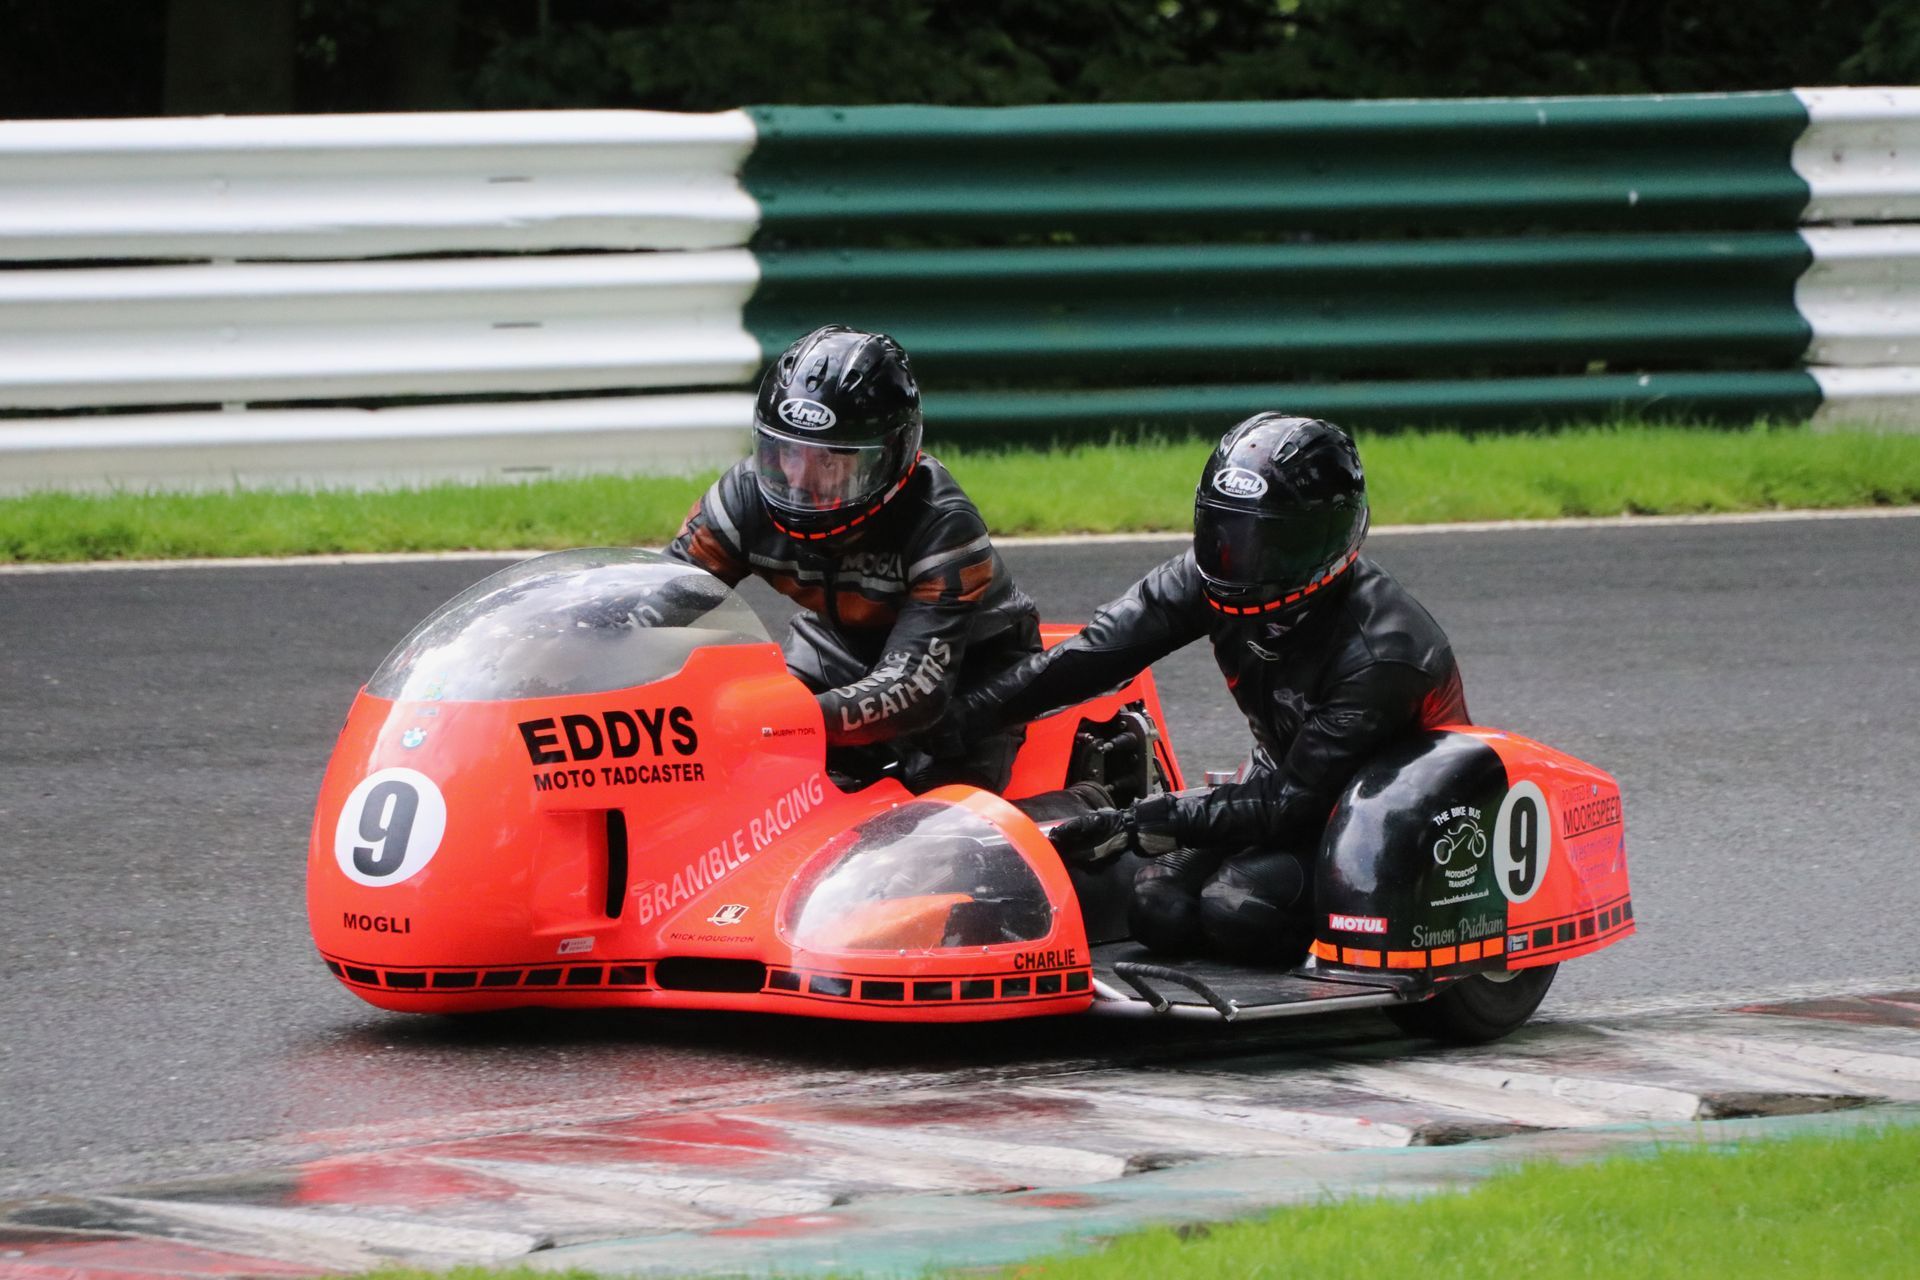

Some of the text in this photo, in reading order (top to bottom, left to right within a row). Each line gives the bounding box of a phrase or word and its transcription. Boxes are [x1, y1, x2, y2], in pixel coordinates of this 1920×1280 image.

[783, 400, 829, 425] Arai
[1218, 469, 1262, 493] Arai
[517, 706, 698, 766] EDDYS
[533, 763, 705, 792] MOTO TADCASTER
[1433, 806, 1481, 826] THE BIKE BUS
[1563, 795, 1621, 835] MOORESPEED
[353, 780, 420, 877] 9
[638, 773, 825, 926] BRAMBLE RACING
[1508, 796, 1538, 896] 9
[1448, 876, 1475, 888] TRANSPORT
[343, 912, 411, 934] MOGLI
[1331, 917, 1385, 933] MOTUL
[1411, 913, 1505, 948] Simon Pridham
[670, 931, 755, 943] NICK HOUGHTON
[1014, 948, 1076, 970] CHARLIE
